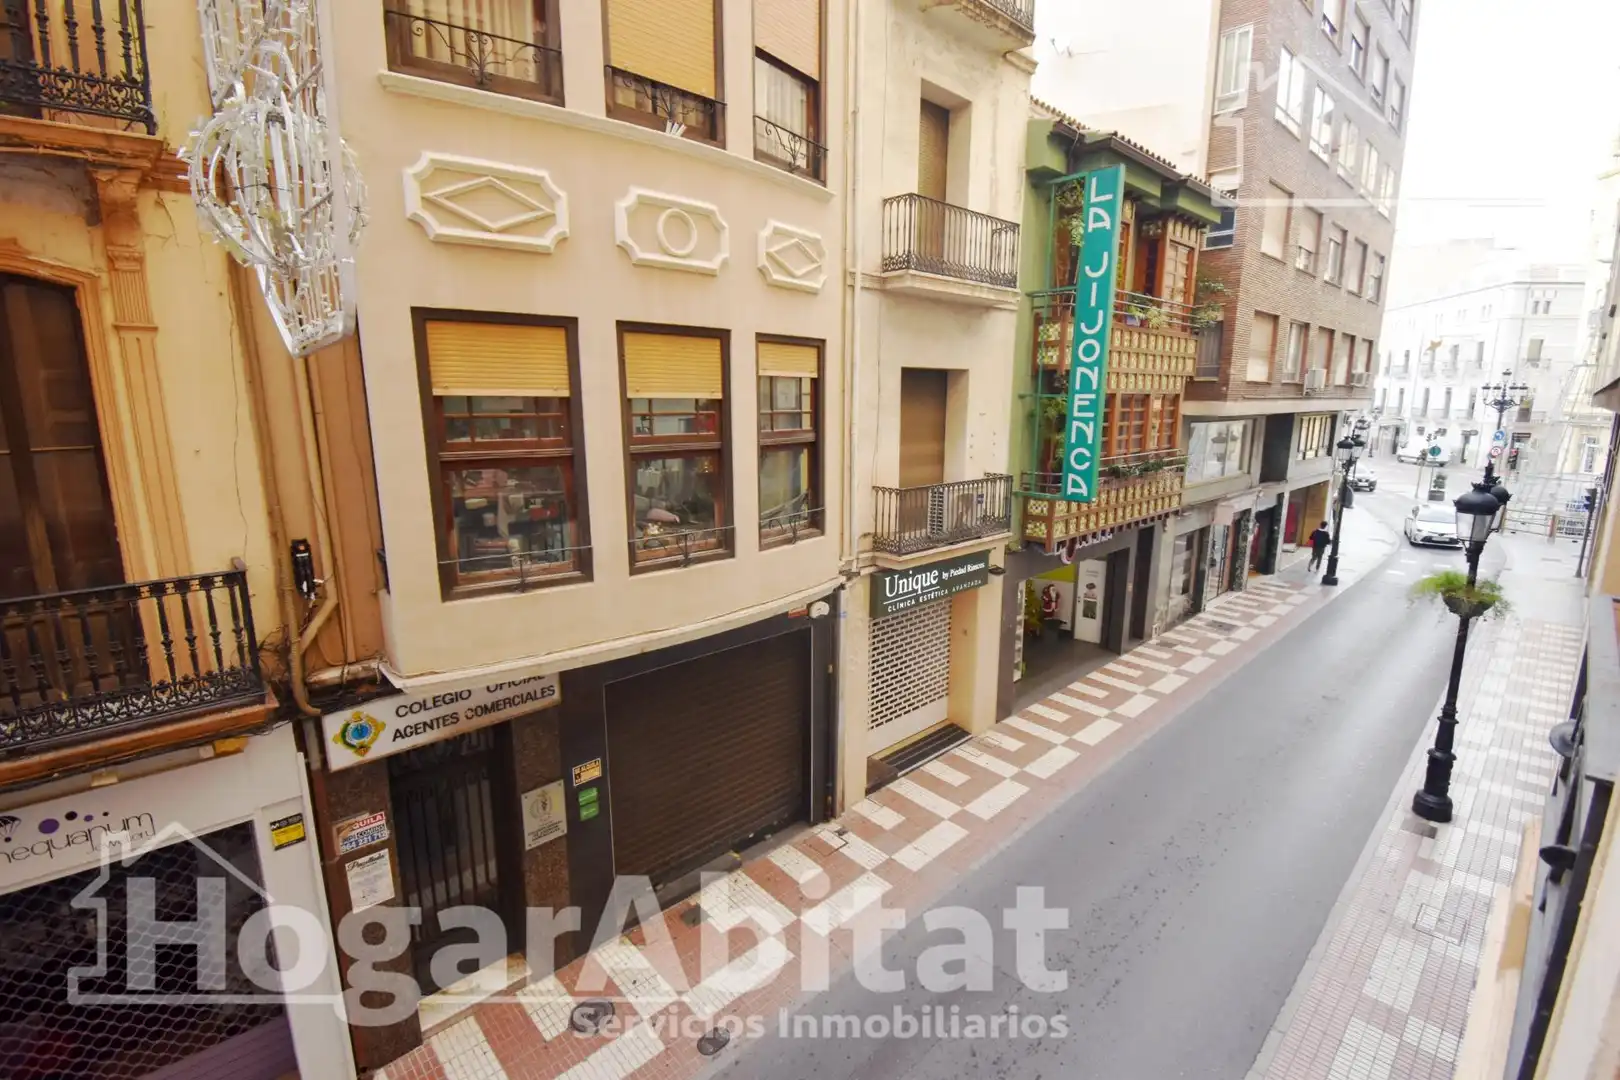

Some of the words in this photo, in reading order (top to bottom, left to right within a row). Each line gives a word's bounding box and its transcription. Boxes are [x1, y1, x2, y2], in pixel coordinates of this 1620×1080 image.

[1088, 176, 1114, 233] LA
[1066, 251, 1109, 497] JIJONENCA
[884, 569, 939, 598] Unique
[942, 571, 950, 581] by
[887, 598, 916, 612] CLÍNICA
[919, 589, 949, 603] ESTÉTICA
[392, 711, 460, 742] AGENTES
[464, 685, 556, 720] COMERCIALES
[395, 689, 472, 718] COLEGIO
